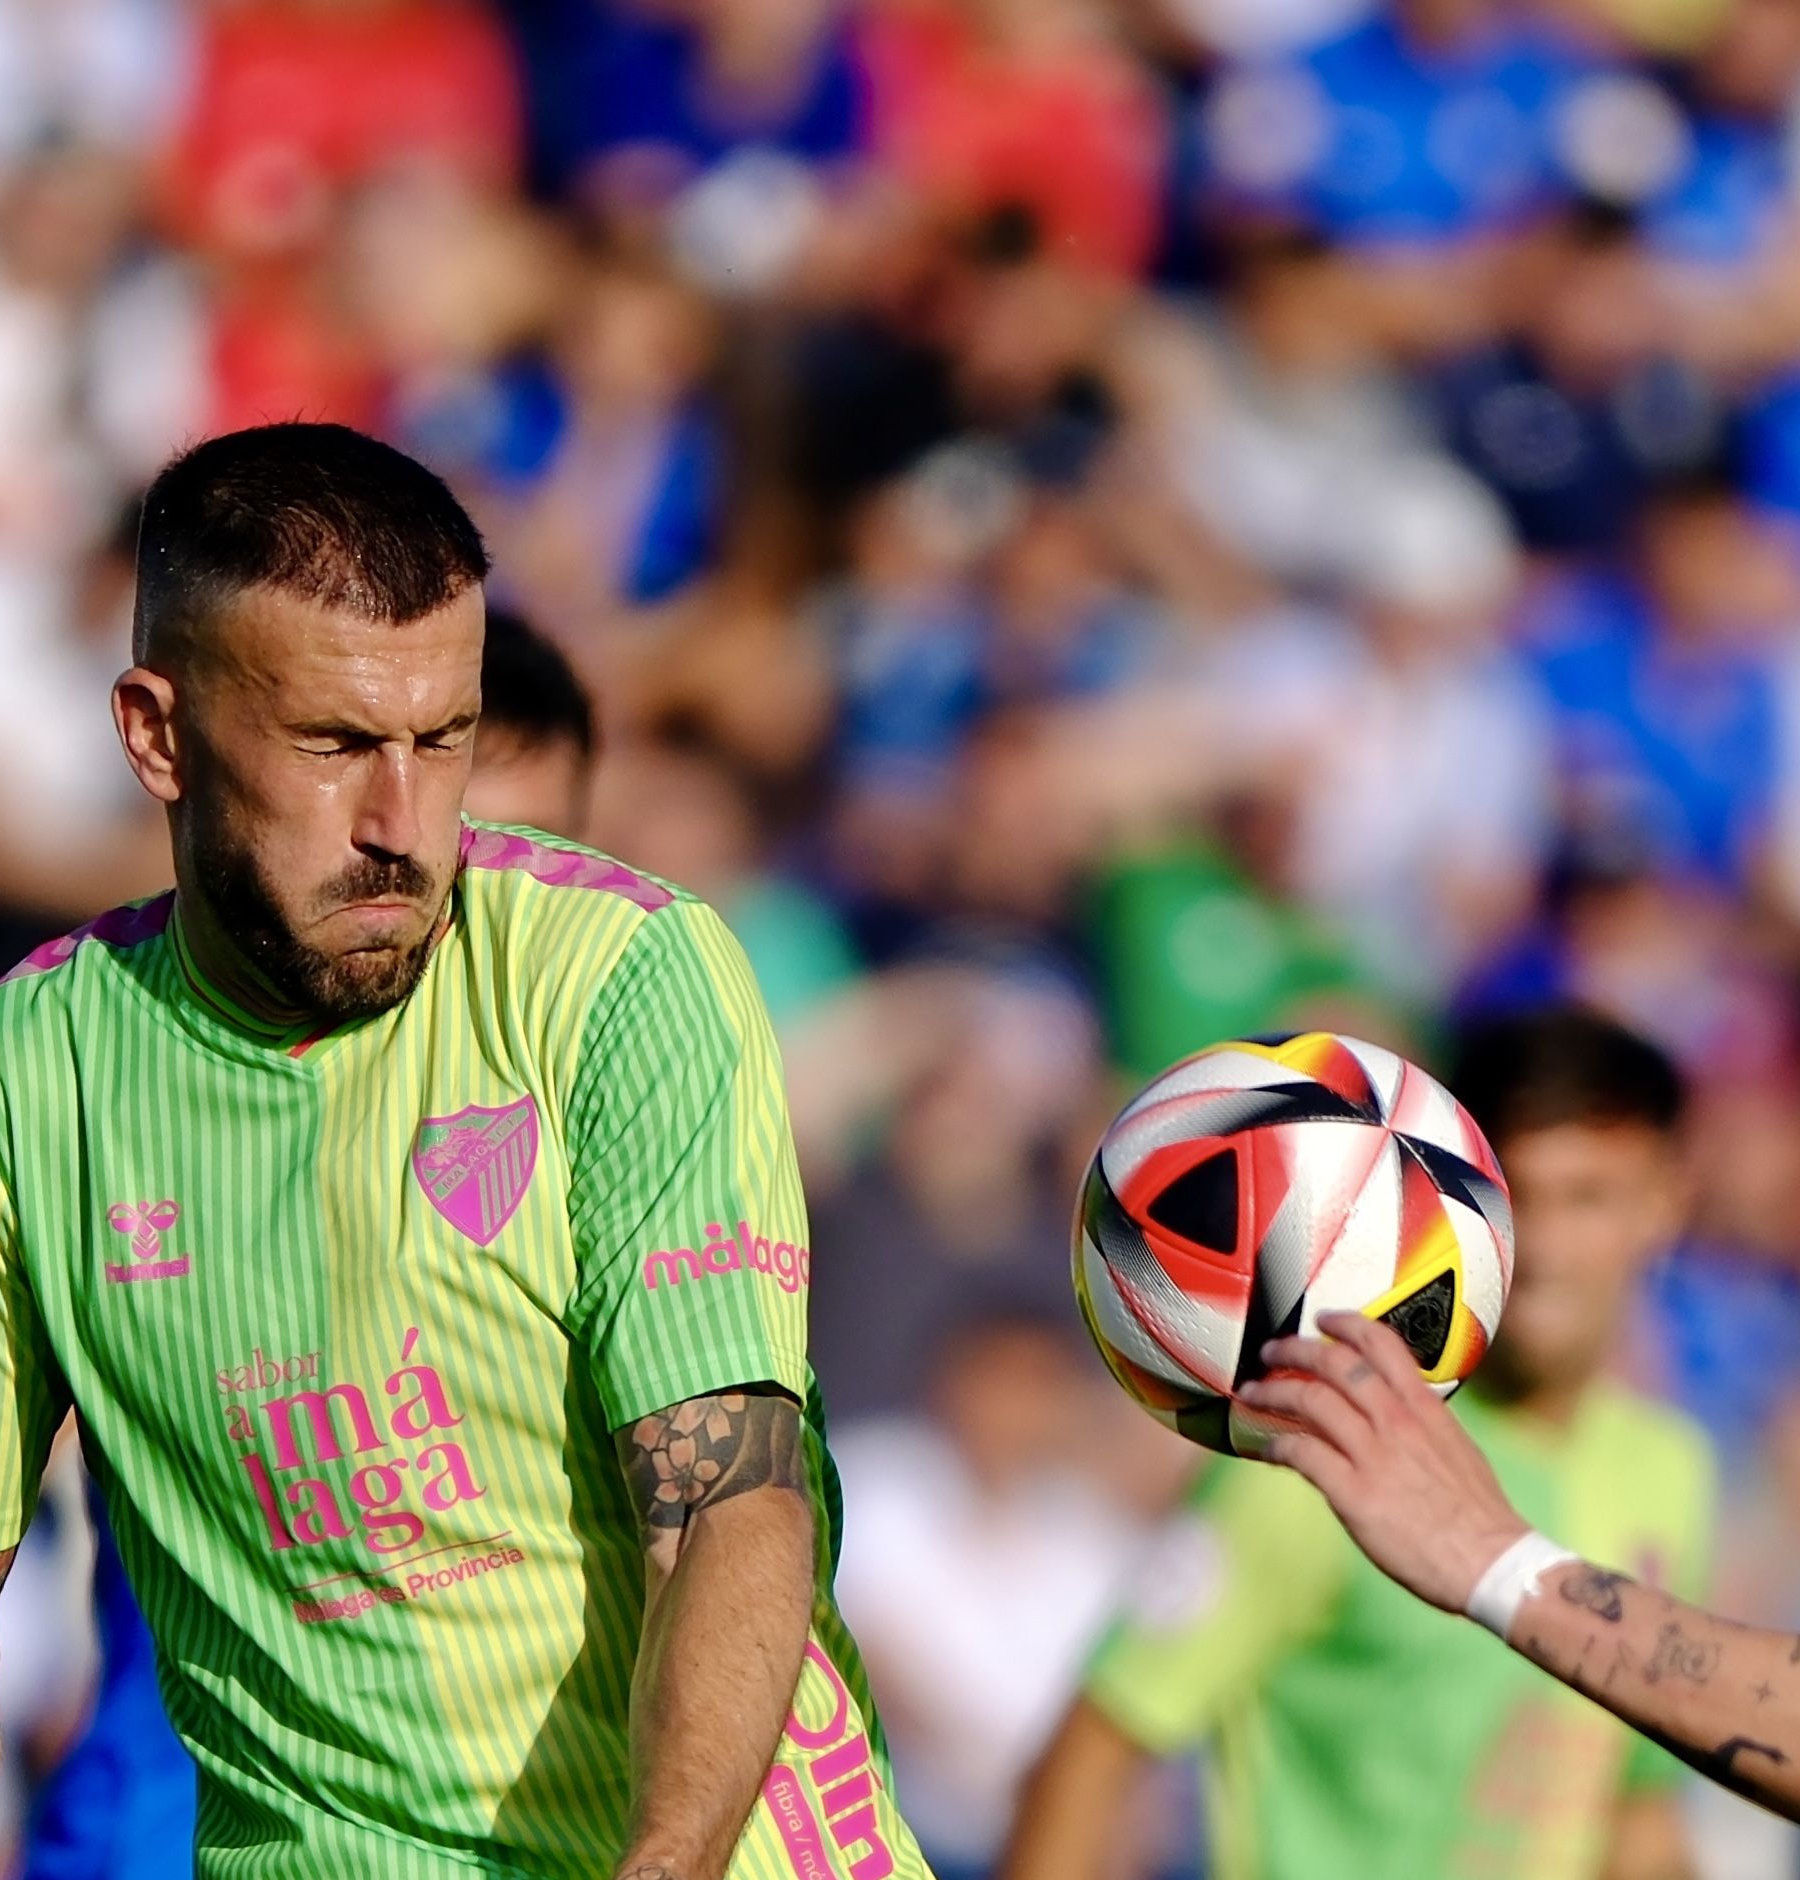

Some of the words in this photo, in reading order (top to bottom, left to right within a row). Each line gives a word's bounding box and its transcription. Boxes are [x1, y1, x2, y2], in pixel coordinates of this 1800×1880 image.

[216, 1348, 322, 1394] sabor
[225, 1404, 257, 1440] a
[260, 1326, 465, 1471] má
[239, 1442, 487, 1553] laga
[378, 1586, 407, 1602] es
[406, 1547, 525, 1599] Provincia
[772, 1780, 804, 1832] fibra
